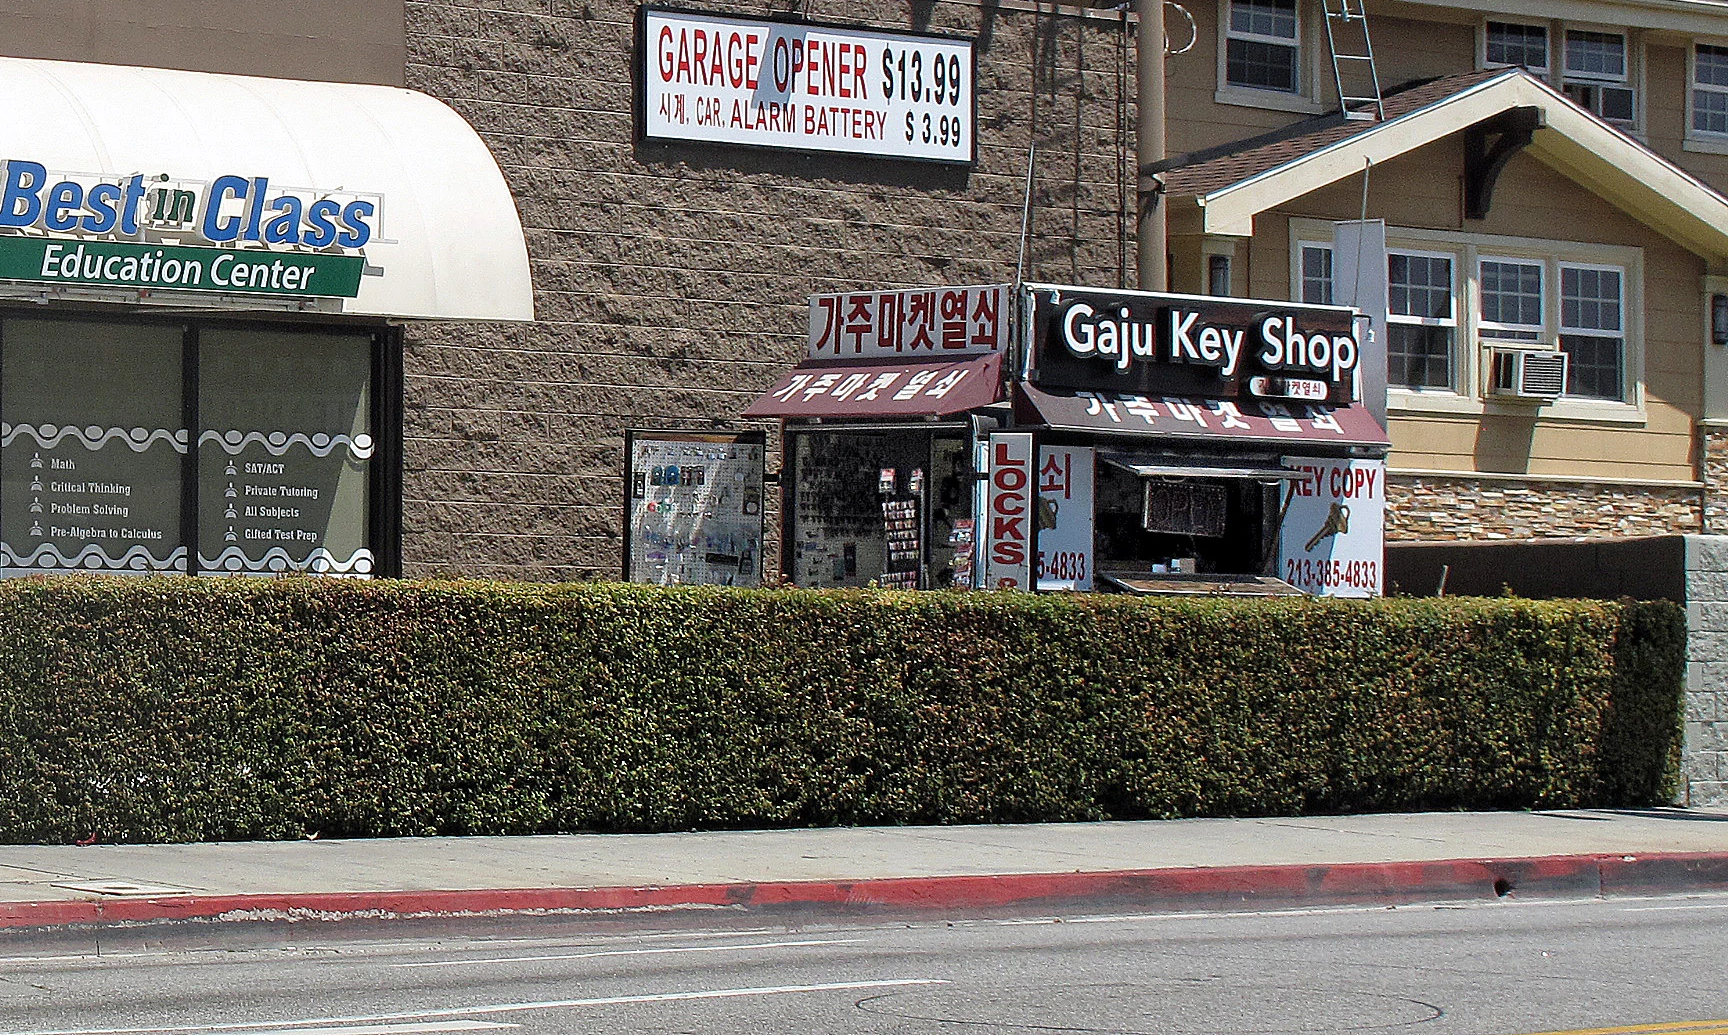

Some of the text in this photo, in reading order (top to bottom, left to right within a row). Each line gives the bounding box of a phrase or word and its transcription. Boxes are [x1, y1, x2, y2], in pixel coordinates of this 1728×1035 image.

[659, 25, 961, 106] GARAGE OPENER $13.99
[730, 99, 796, 133] ALARM
[805, 105, 887, 140] BATTERY
[921, 113, 961, 147] 3.99
[152, 173, 197, 223] in
[204, 174, 375, 249] Class
[41, 244, 316, 291] Education Center
[1064, 303, 1357, 382] Gaju Key Shop
[50, 458, 76, 470] Math
[244, 463, 285, 474] SAT/ACT
[50, 481, 132, 496] Critical Thinking
[244, 485, 319, 499] Private Tutoring
[1330, 466, 1377, 499] COPY
[50, 503, 129, 517] Problem Solving
[244, 506, 300, 519] All Subjects
[992, 443, 1028, 565] LOCKS
[50, 526, 162, 539] Pre-Algebra to Calculus
[244, 529, 318, 542] Gifted Test Prep
[1287, 558, 1377, 589] 213-385-4833
